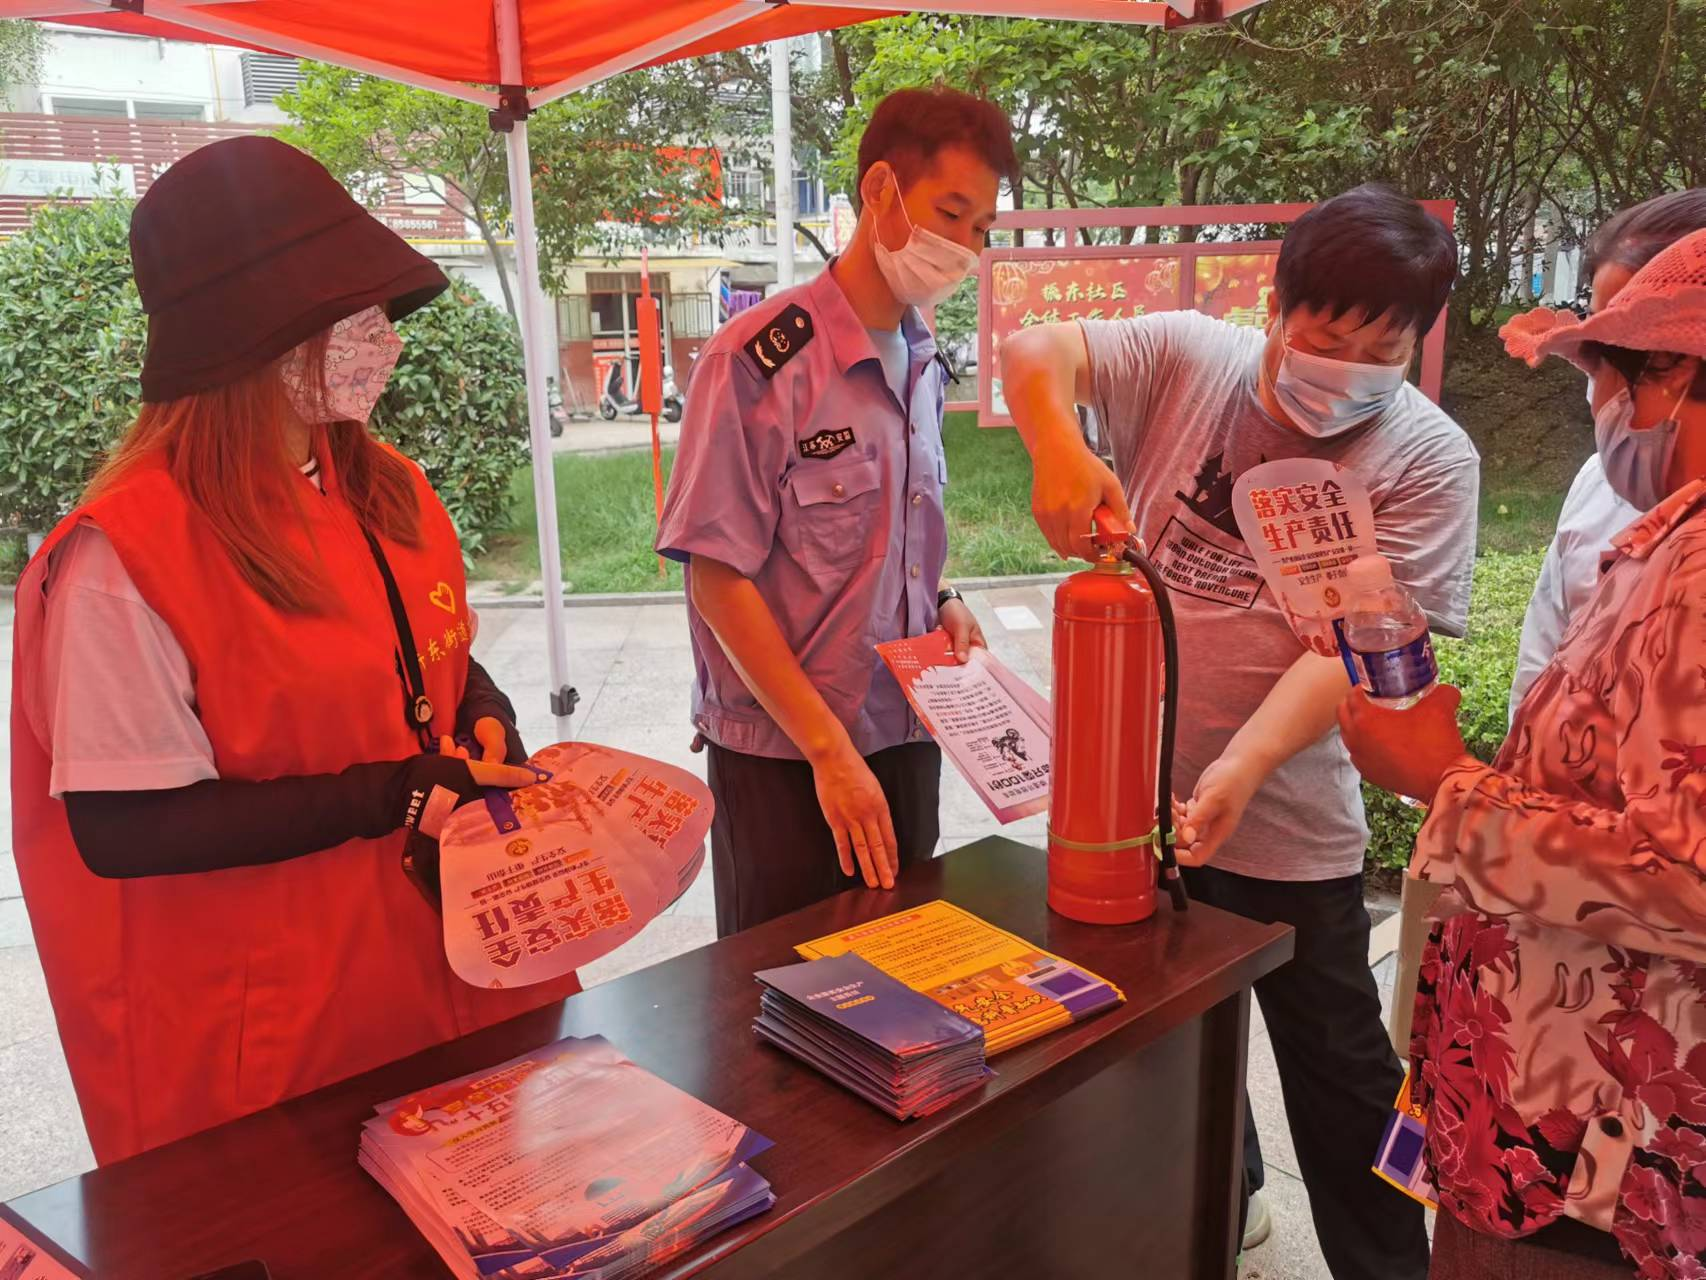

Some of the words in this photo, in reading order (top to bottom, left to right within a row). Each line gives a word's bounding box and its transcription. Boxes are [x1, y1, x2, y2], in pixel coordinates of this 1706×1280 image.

[1250, 480, 1347, 519] 落实安全
[1262, 511, 1358, 551] 生产责任
[472, 866, 615, 940] 生产责任
[485, 894, 630, 967] 落实安全
